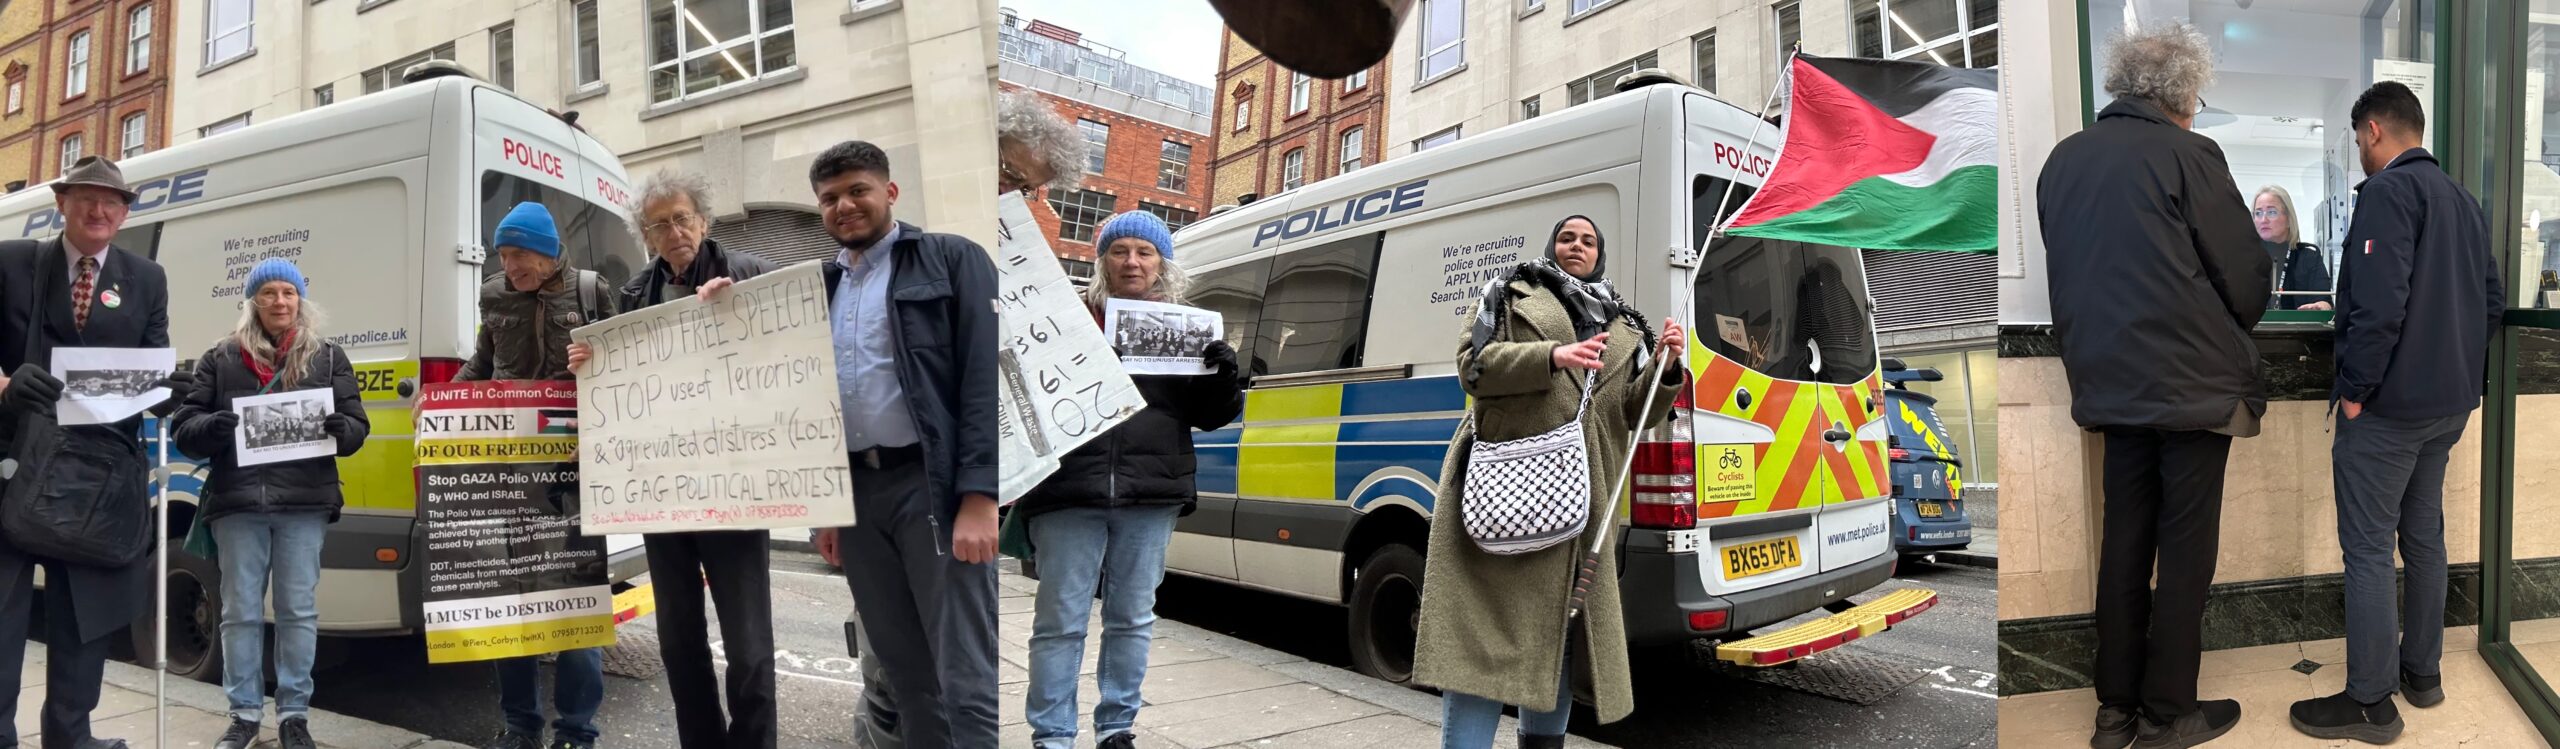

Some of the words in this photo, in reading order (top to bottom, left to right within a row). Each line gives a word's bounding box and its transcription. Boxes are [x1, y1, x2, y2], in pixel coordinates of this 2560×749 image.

[503, 138, 564, 179] POLICE
[1253, 179, 1430, 248] POLICE
[224, 237, 254, 251] We're
[258, 229, 310, 246] recruiting
[1443, 244, 1472, 258] We're
[1474, 235, 1525, 253] recruiting
[225, 252, 257, 268] police
[260, 246, 302, 261] officers
[1444, 258, 1474, 275] police
[1477, 252, 1518, 267] officers
[227, 265, 252, 281] APP
[1445, 270, 1480, 287] APPLY
[1430, 288, 1465, 304] Search
[584, 316, 674, 380] DEFEND
[679, 300, 729, 354] FREE
[731, 271, 829, 342] SPEECH!
[431, 389, 468, 401] UNITE
[472, 388, 483, 399] in
[487, 388, 542, 399] Common
[545, 387, 578, 398] Cause
[591, 374, 662, 430] STOP
[670, 381, 695, 401] use
[696, 368, 713, 400] of
[717, 352, 822, 397] Terrorism
[1009, 372, 1029, 407] General
[1022, 403, 1038, 435] Waste
[460, 414, 515, 432] LINE
[417, 444, 439, 458] OF
[443, 444, 480, 458] OUR
[594, 443, 610, 465] &
[428, 475, 457, 487] Stop
[460, 473, 496, 485] GAZA
[500, 472, 529, 484] Polio
[532, 471, 557, 483] VAX
[589, 480, 614, 507] TO
[624, 474, 668, 503] GAG
[675, 472, 763, 502] POLITICAL
[766, 466, 848, 499] PROTEST
[1717, 471, 1744, 483] Cyclists
[428, 493, 441, 503] By
[444, 491, 469, 501] WHO
[471, 491, 490, 500] and
[492, 490, 527, 500] ISRAEL
[428, 510, 445, 519] The
[446, 509, 468, 518] Polio
[470, 508, 486, 517] Vax
[487, 507, 516, 516] causes
[518, 505, 542, 515] Polio.
[428, 530, 468, 540] achieved
[470, 528, 480, 538] by
[482, 526, 523, 537] re-naming
[525, 519, 569, 532] symptoms
[429, 540, 461, 550] caused
[463, 540, 474, 549] by
[476, 538, 509, 548] another
[509, 535, 531, 546] (new)
[533, 530, 568, 541] disease.
[1827, 521, 1887, 547] www.met.police.uk
[430, 561, 452, 571] DDT,
[454, 557, 508, 570] insecticides,
[510, 554, 542, 565] mercury
[544, 551, 551, 560] &
[553, 549, 597, 561] poisonous
[1729, 544, 1769, 573] BX65
[1770, 539, 1796, 565] DFA
[430, 571, 475, 582] chemicals
[477, 569, 497, 579] from
[499, 566, 530, 577] modern
[531, 561, 577, 574] explosives
[431, 584, 458, 593] cause
[459, 581, 501, 592] paralysis.
[437, 608, 483, 624] MUST
[485, 607, 502, 619] be
[506, 596, 598, 617] DESTROYED
[462, 635, 519, 648] @Piers_Corbyn
